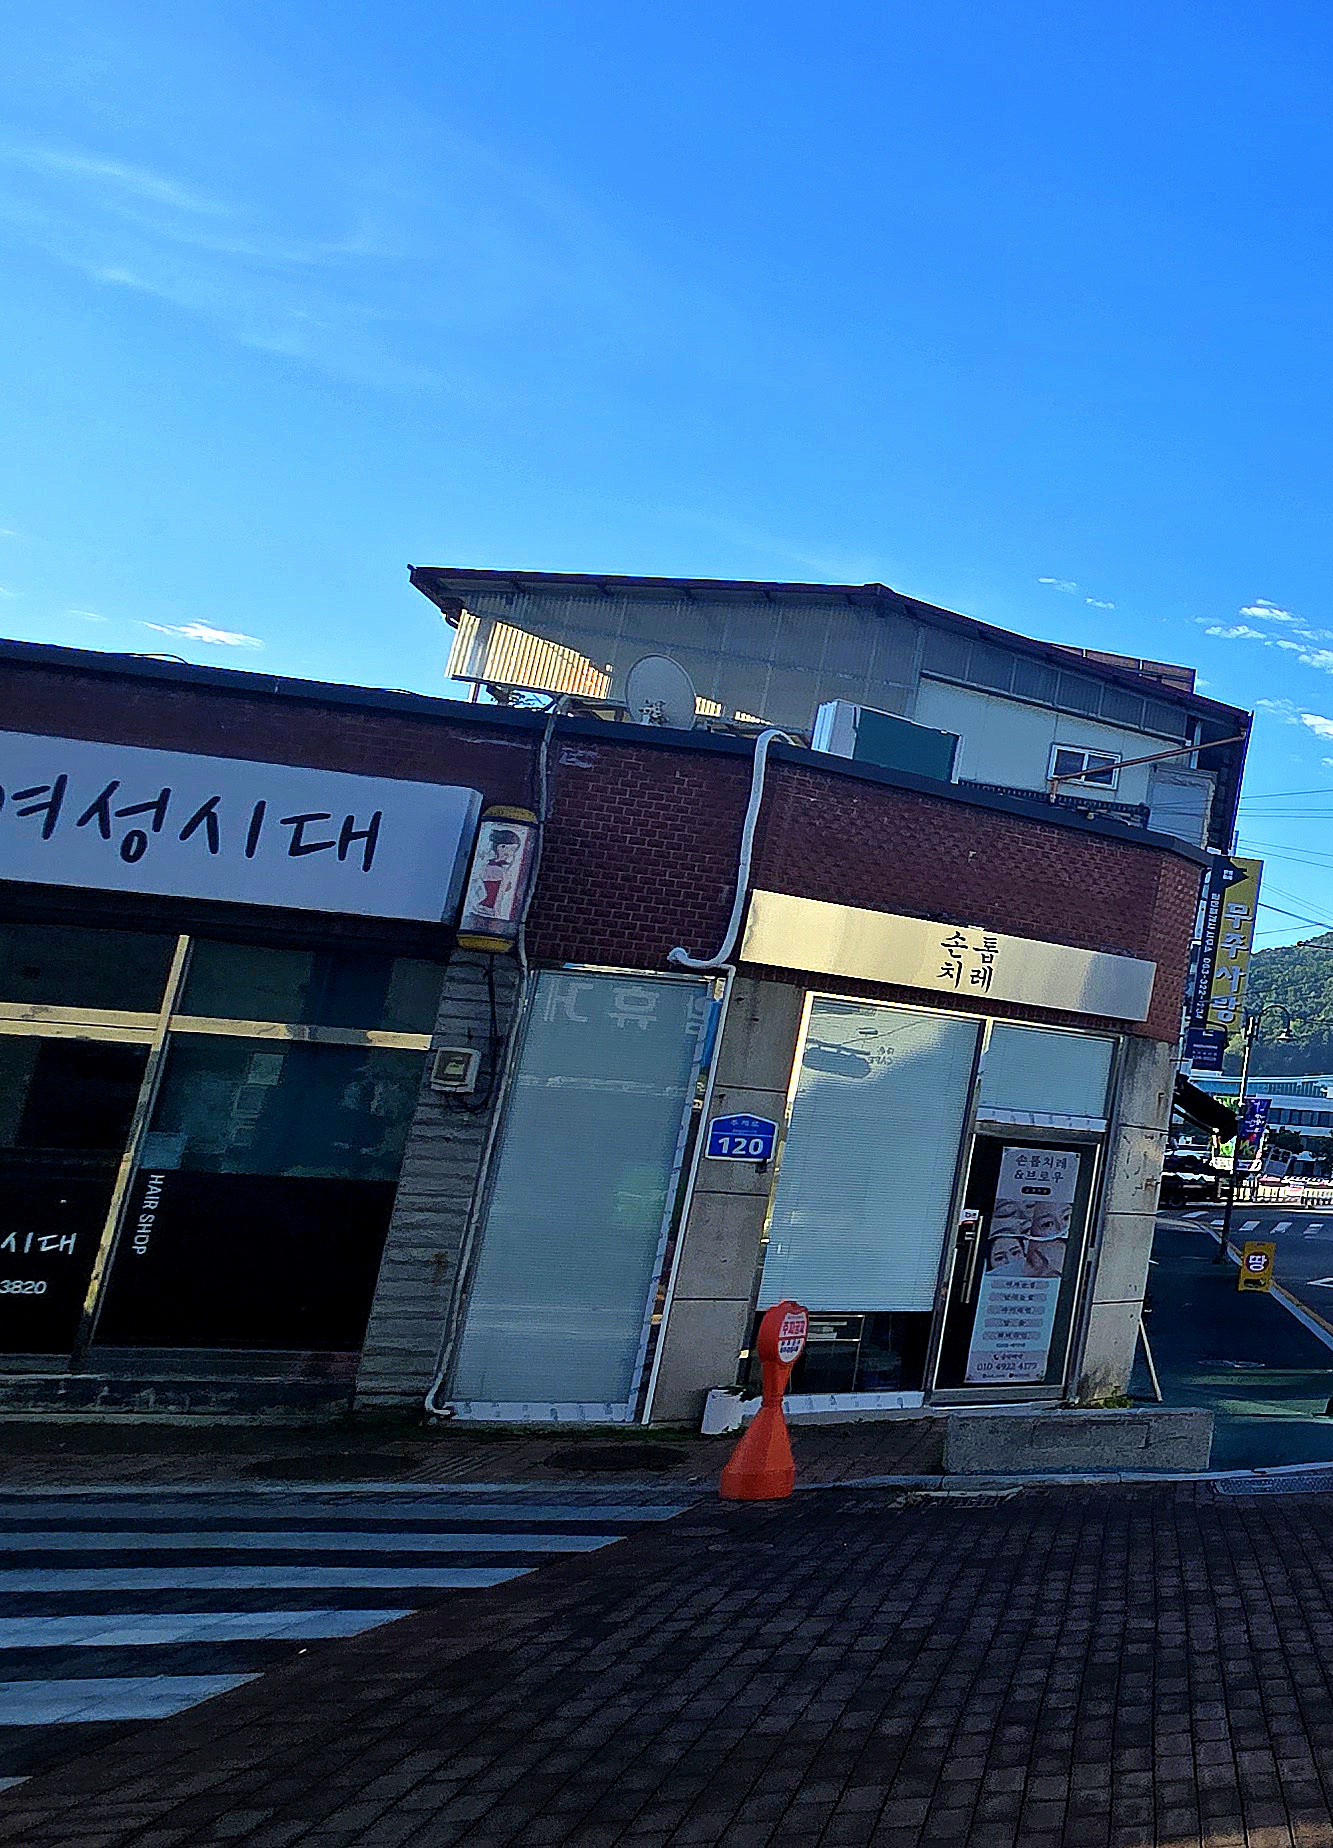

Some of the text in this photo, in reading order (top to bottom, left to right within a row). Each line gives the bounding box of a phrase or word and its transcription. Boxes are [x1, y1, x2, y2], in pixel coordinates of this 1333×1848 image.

[0, 773, 382, 872] 여성시대
[940, 930, 999, 964] 손톱
[1210, 902, 1253, 1023] 무주사랑
[936, 960, 994, 993] 치레
[718, 1137, 764, 1155] 120
[1015, 1154, 1067, 1169] 손톱치레
[132, 1174, 165, 1255] HAIR SHOP
[0, 1280, 47, 1294] 3820
